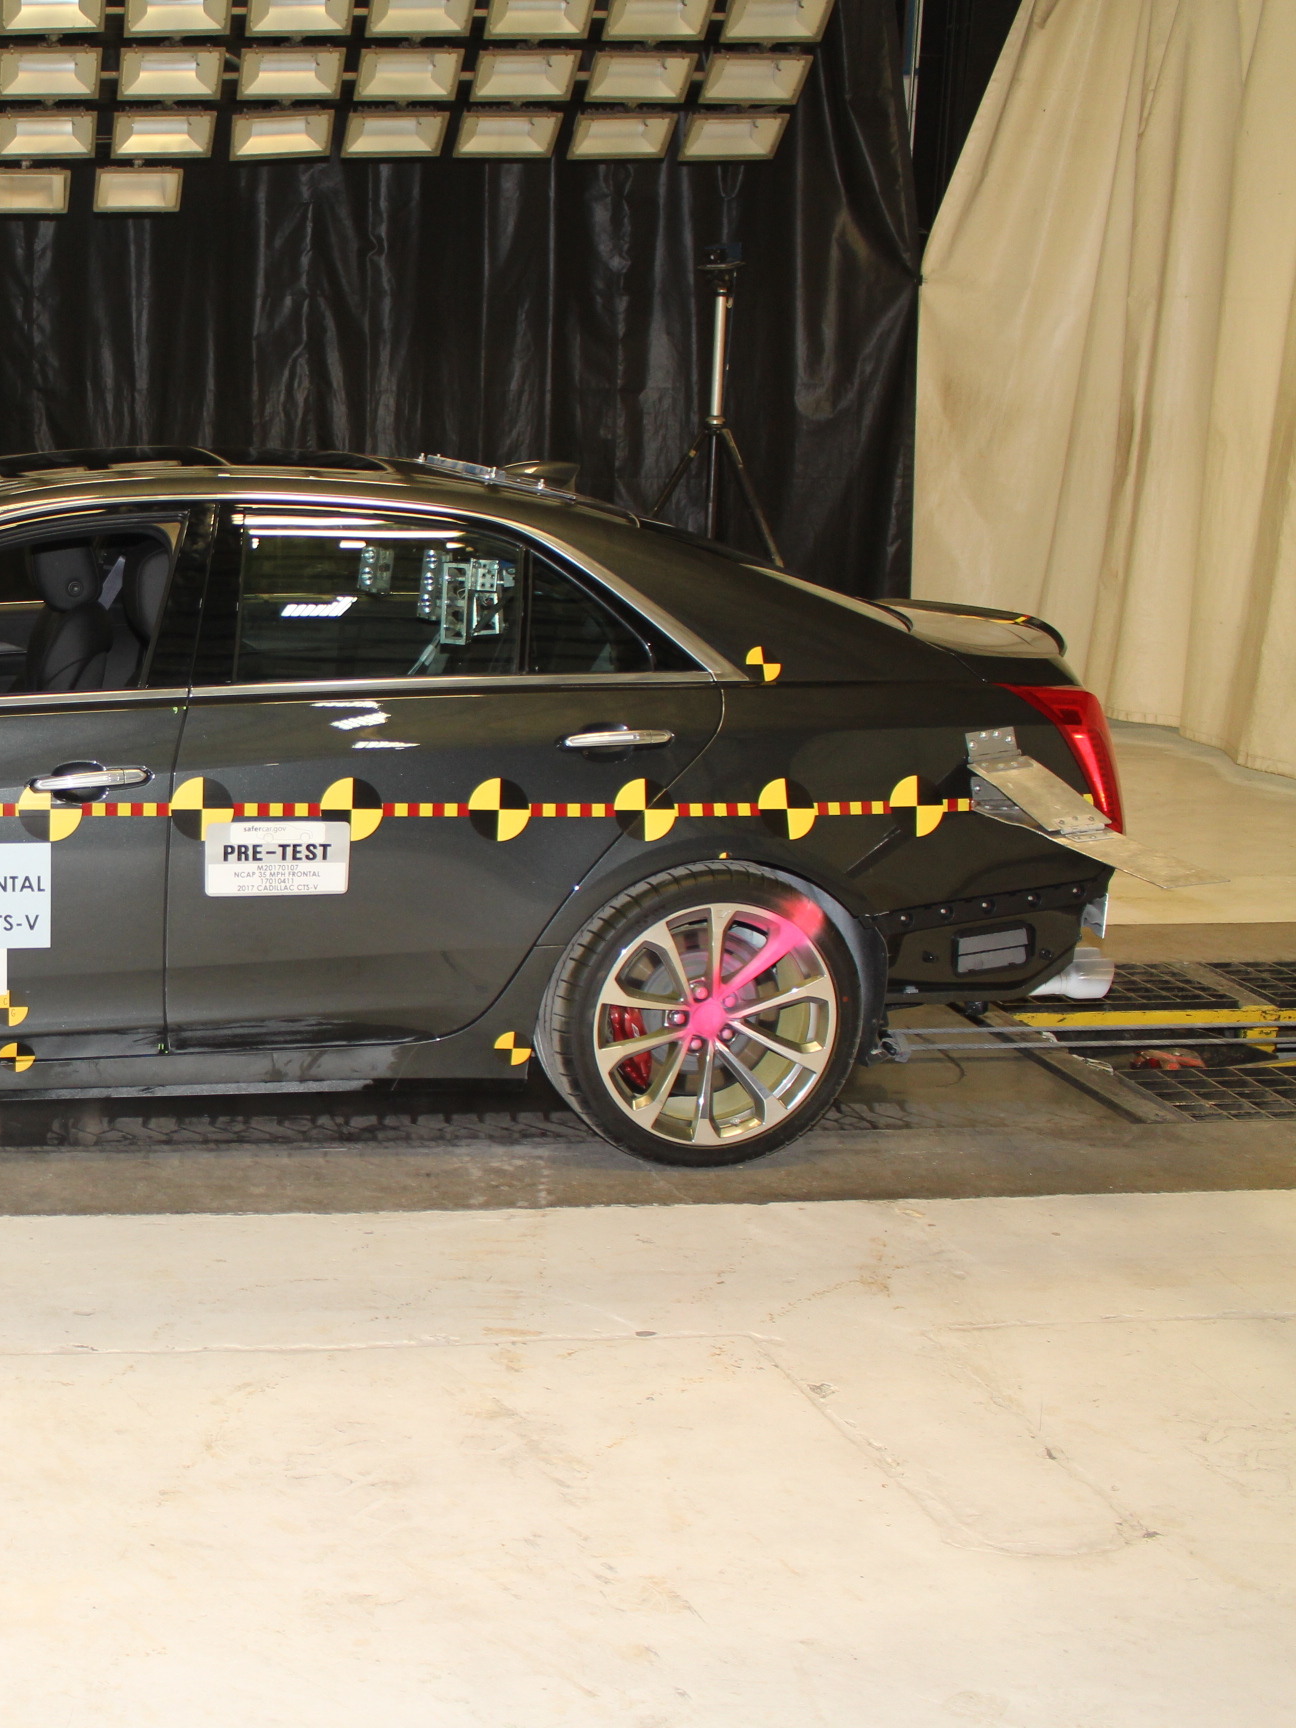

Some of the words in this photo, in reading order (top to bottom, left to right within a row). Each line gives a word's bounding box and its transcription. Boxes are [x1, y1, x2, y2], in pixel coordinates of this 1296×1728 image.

[243, 825, 286, 834] safercar.gov
[223, 843, 332, 862] PRE-TEST
[256, 864, 299, 872] M20170107
